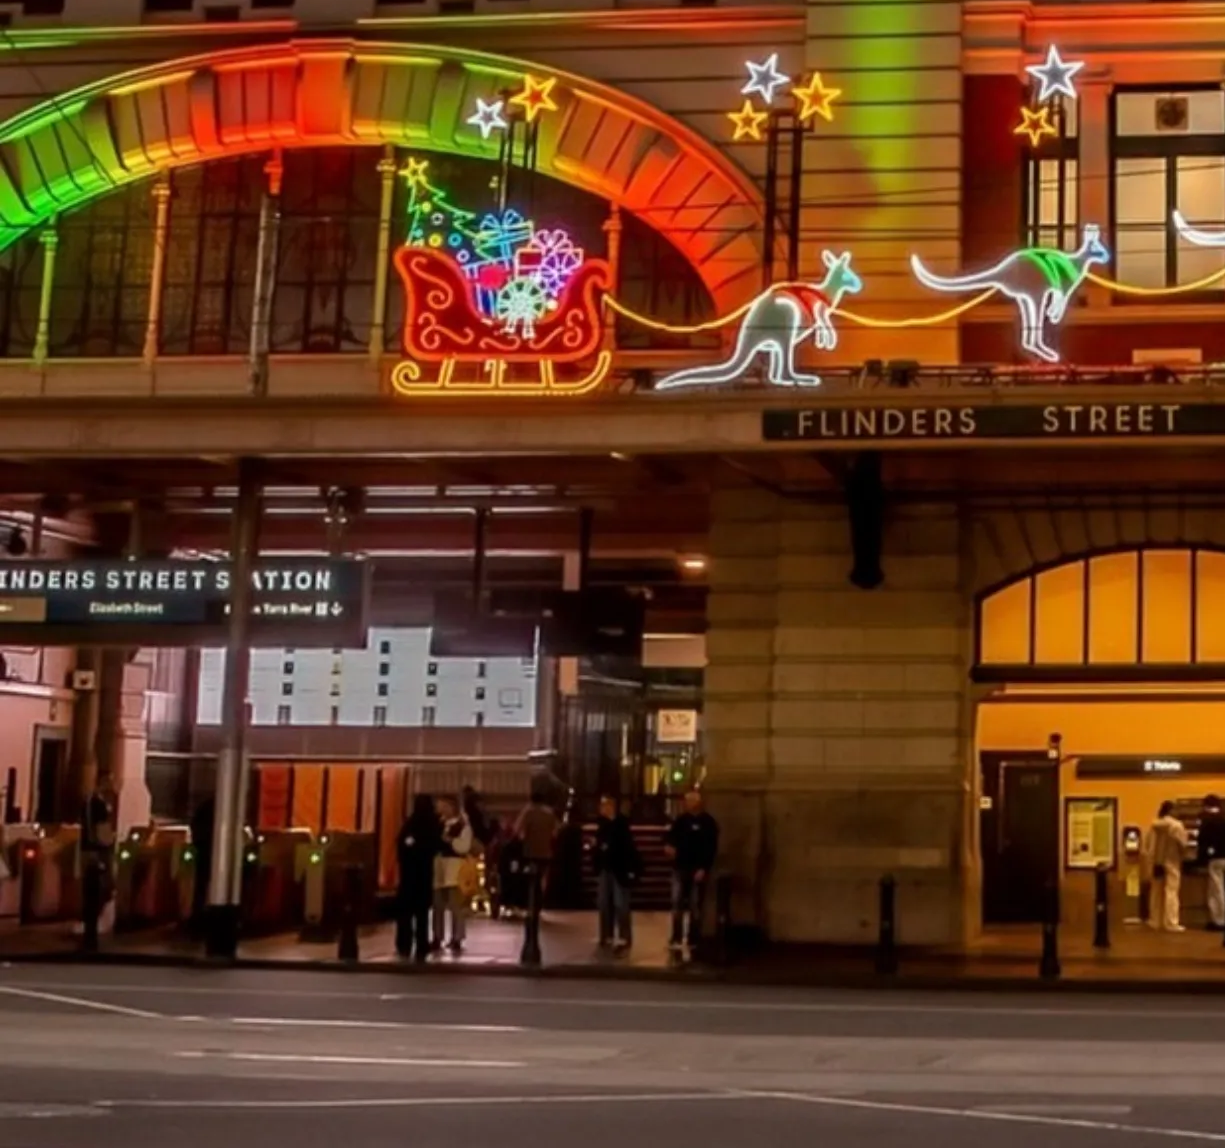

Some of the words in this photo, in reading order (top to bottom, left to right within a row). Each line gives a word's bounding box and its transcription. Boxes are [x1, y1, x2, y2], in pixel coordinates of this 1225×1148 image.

[798, 407, 977, 437] FLINDERS
[1042, 404, 1181, 433] STREET
[106, 569, 205, 590] STREET
[215, 569, 331, 590] STION
